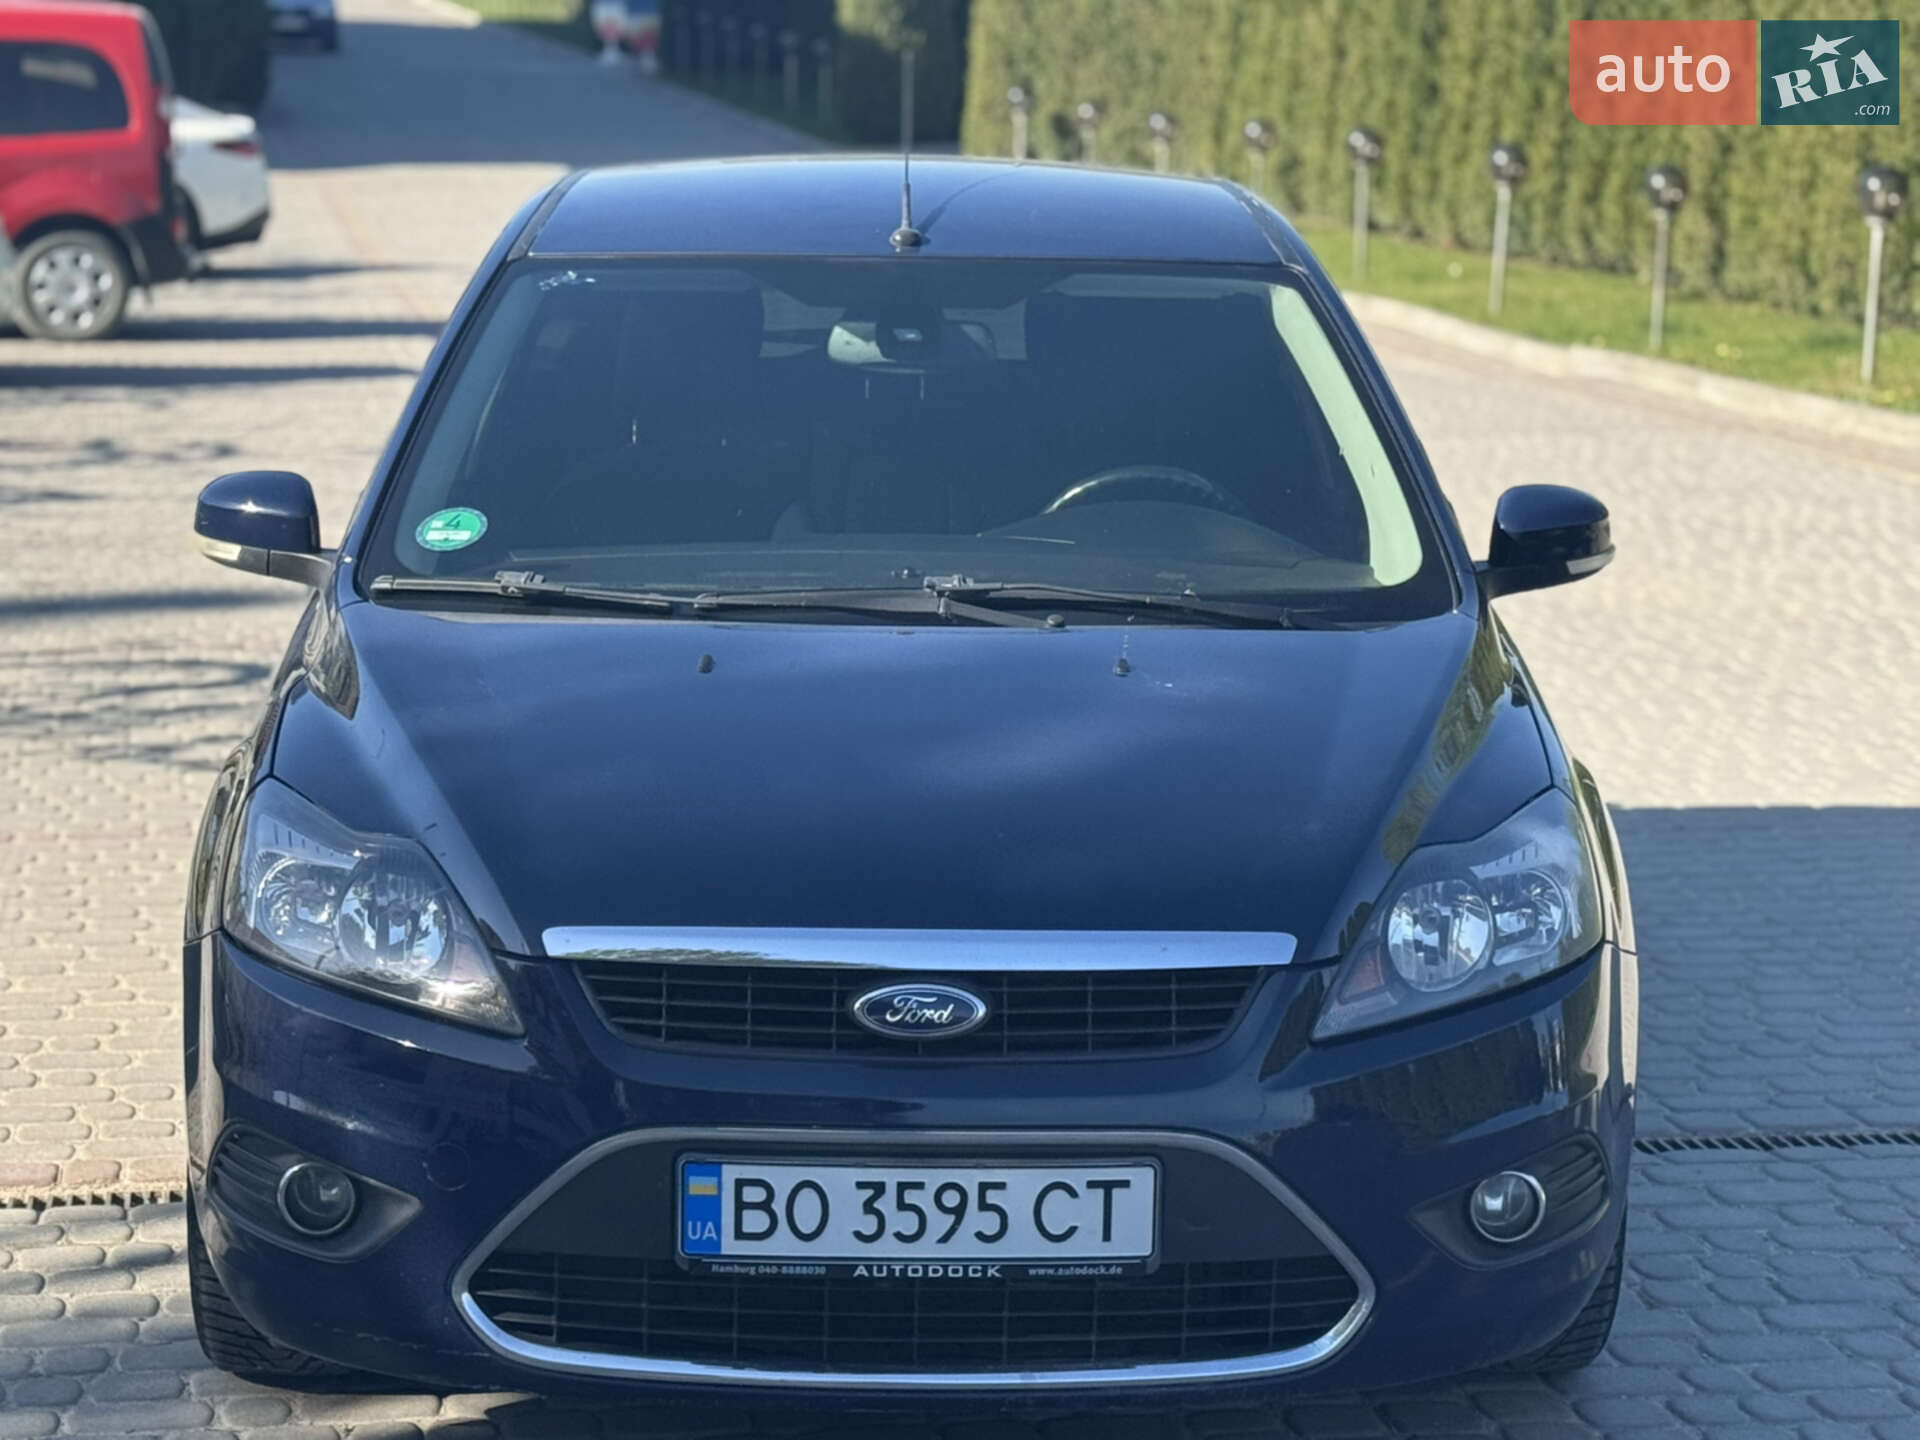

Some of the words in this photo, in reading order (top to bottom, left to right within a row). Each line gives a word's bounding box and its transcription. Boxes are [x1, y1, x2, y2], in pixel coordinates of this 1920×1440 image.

[885, 994, 955, 1024] Ford
[852, 1180, 1009, 1244] 3595
[1032, 1179, 1131, 1243] CT
[687, 1219, 718, 1242] UA
[711, 1263, 756, 1275] Hamburg
[853, 1264, 1003, 1278] AUTODOCK
[1028, 1265, 1123, 1276] www.autodock.de
